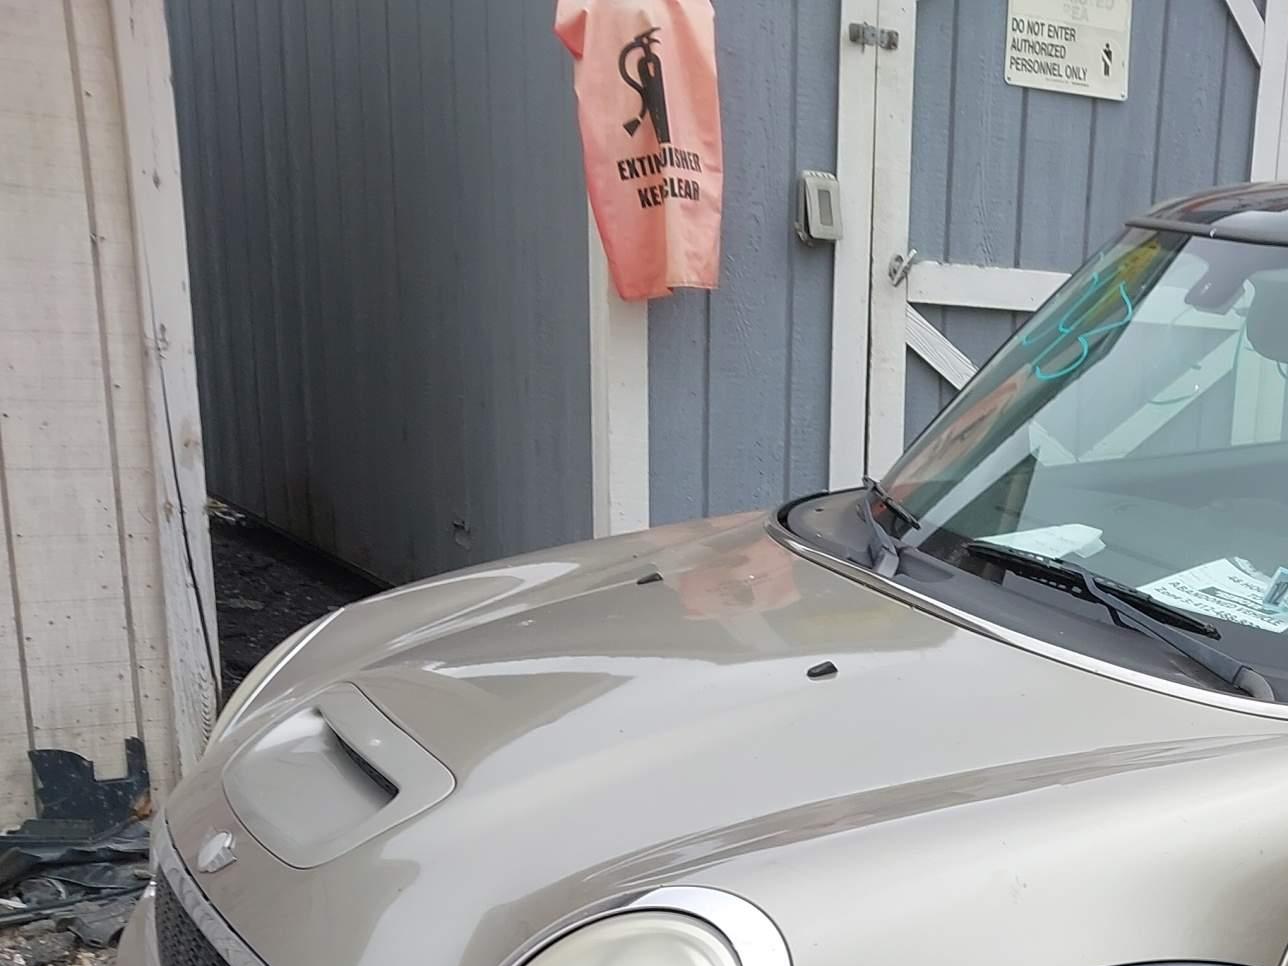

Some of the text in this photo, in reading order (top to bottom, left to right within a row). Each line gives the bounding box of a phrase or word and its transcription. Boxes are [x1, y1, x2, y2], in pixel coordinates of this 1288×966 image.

[1011, 17, 1077, 43] DO NOT ENTER
[1011, 38, 1066, 59] AUTHORIZED
[1010, 57, 1088, 82] PERSONNEL ONLY
[617, 146, 702, 181] EXTINUISHER
